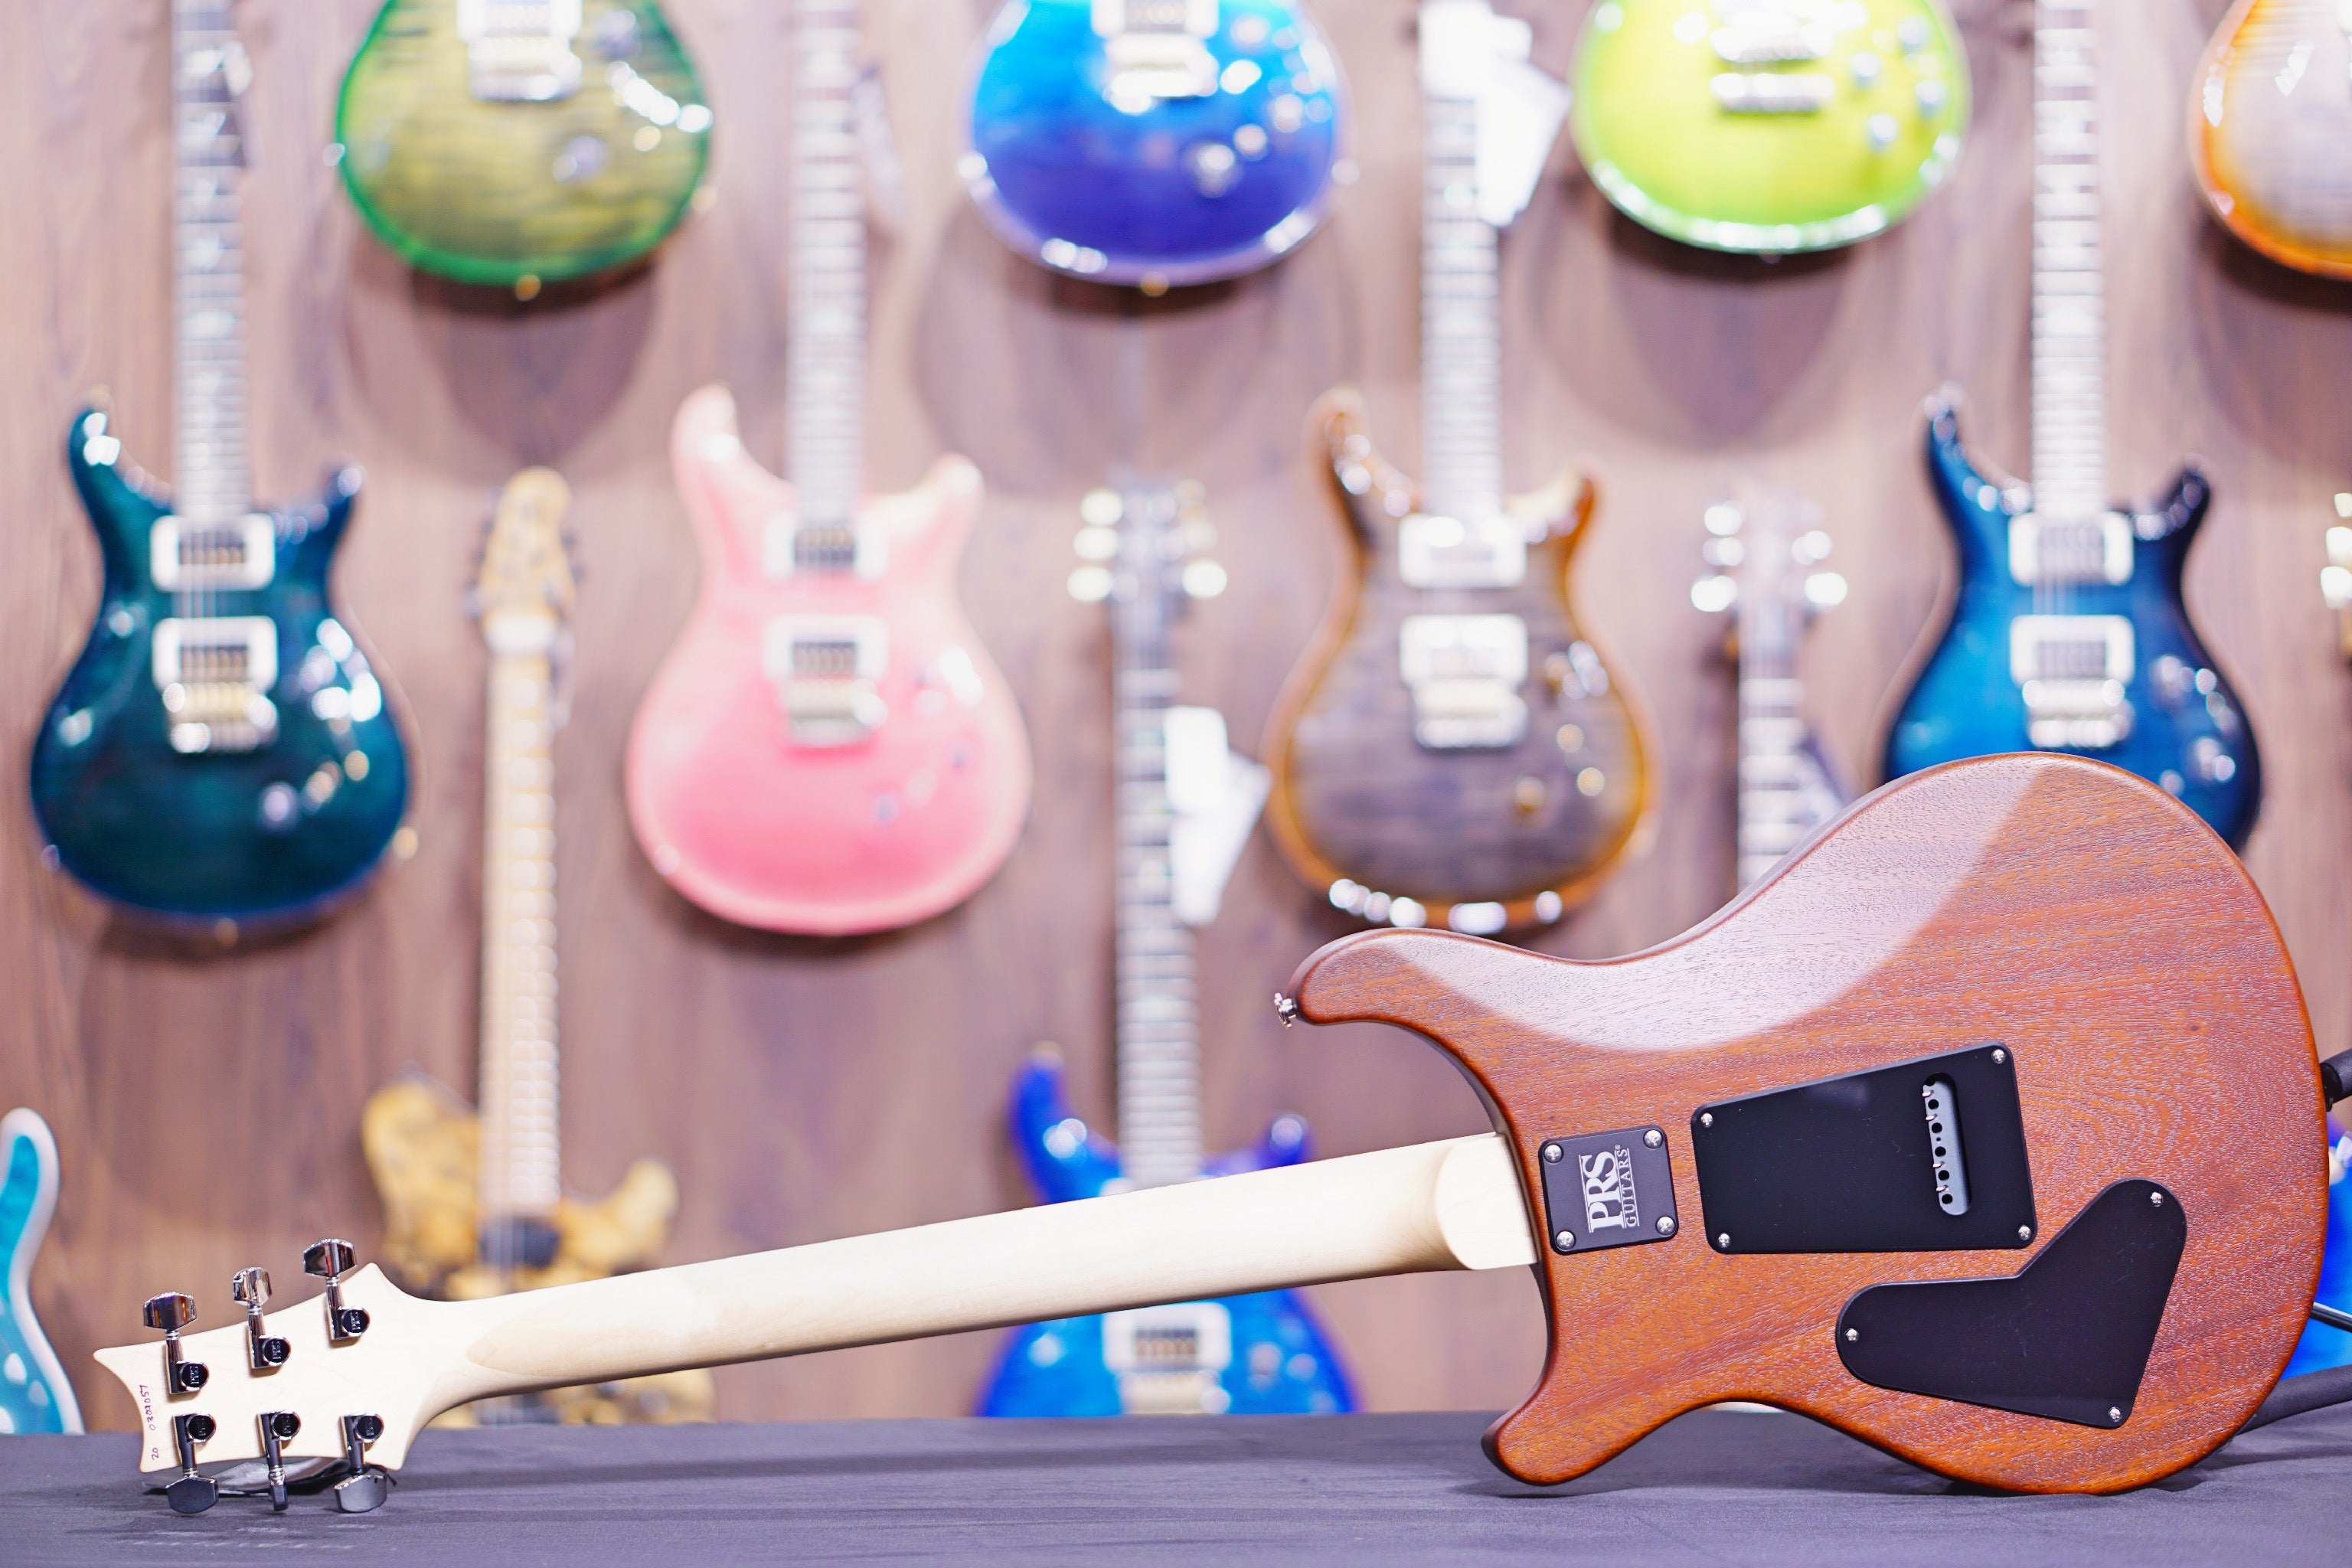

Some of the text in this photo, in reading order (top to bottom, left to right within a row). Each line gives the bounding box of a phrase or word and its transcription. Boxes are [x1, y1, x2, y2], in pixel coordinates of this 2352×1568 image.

[1581, 1151, 1625, 1233] PRS
[1617, 1148, 1637, 1227] GUITARS
[152, 1447, 159, 1461] 20
